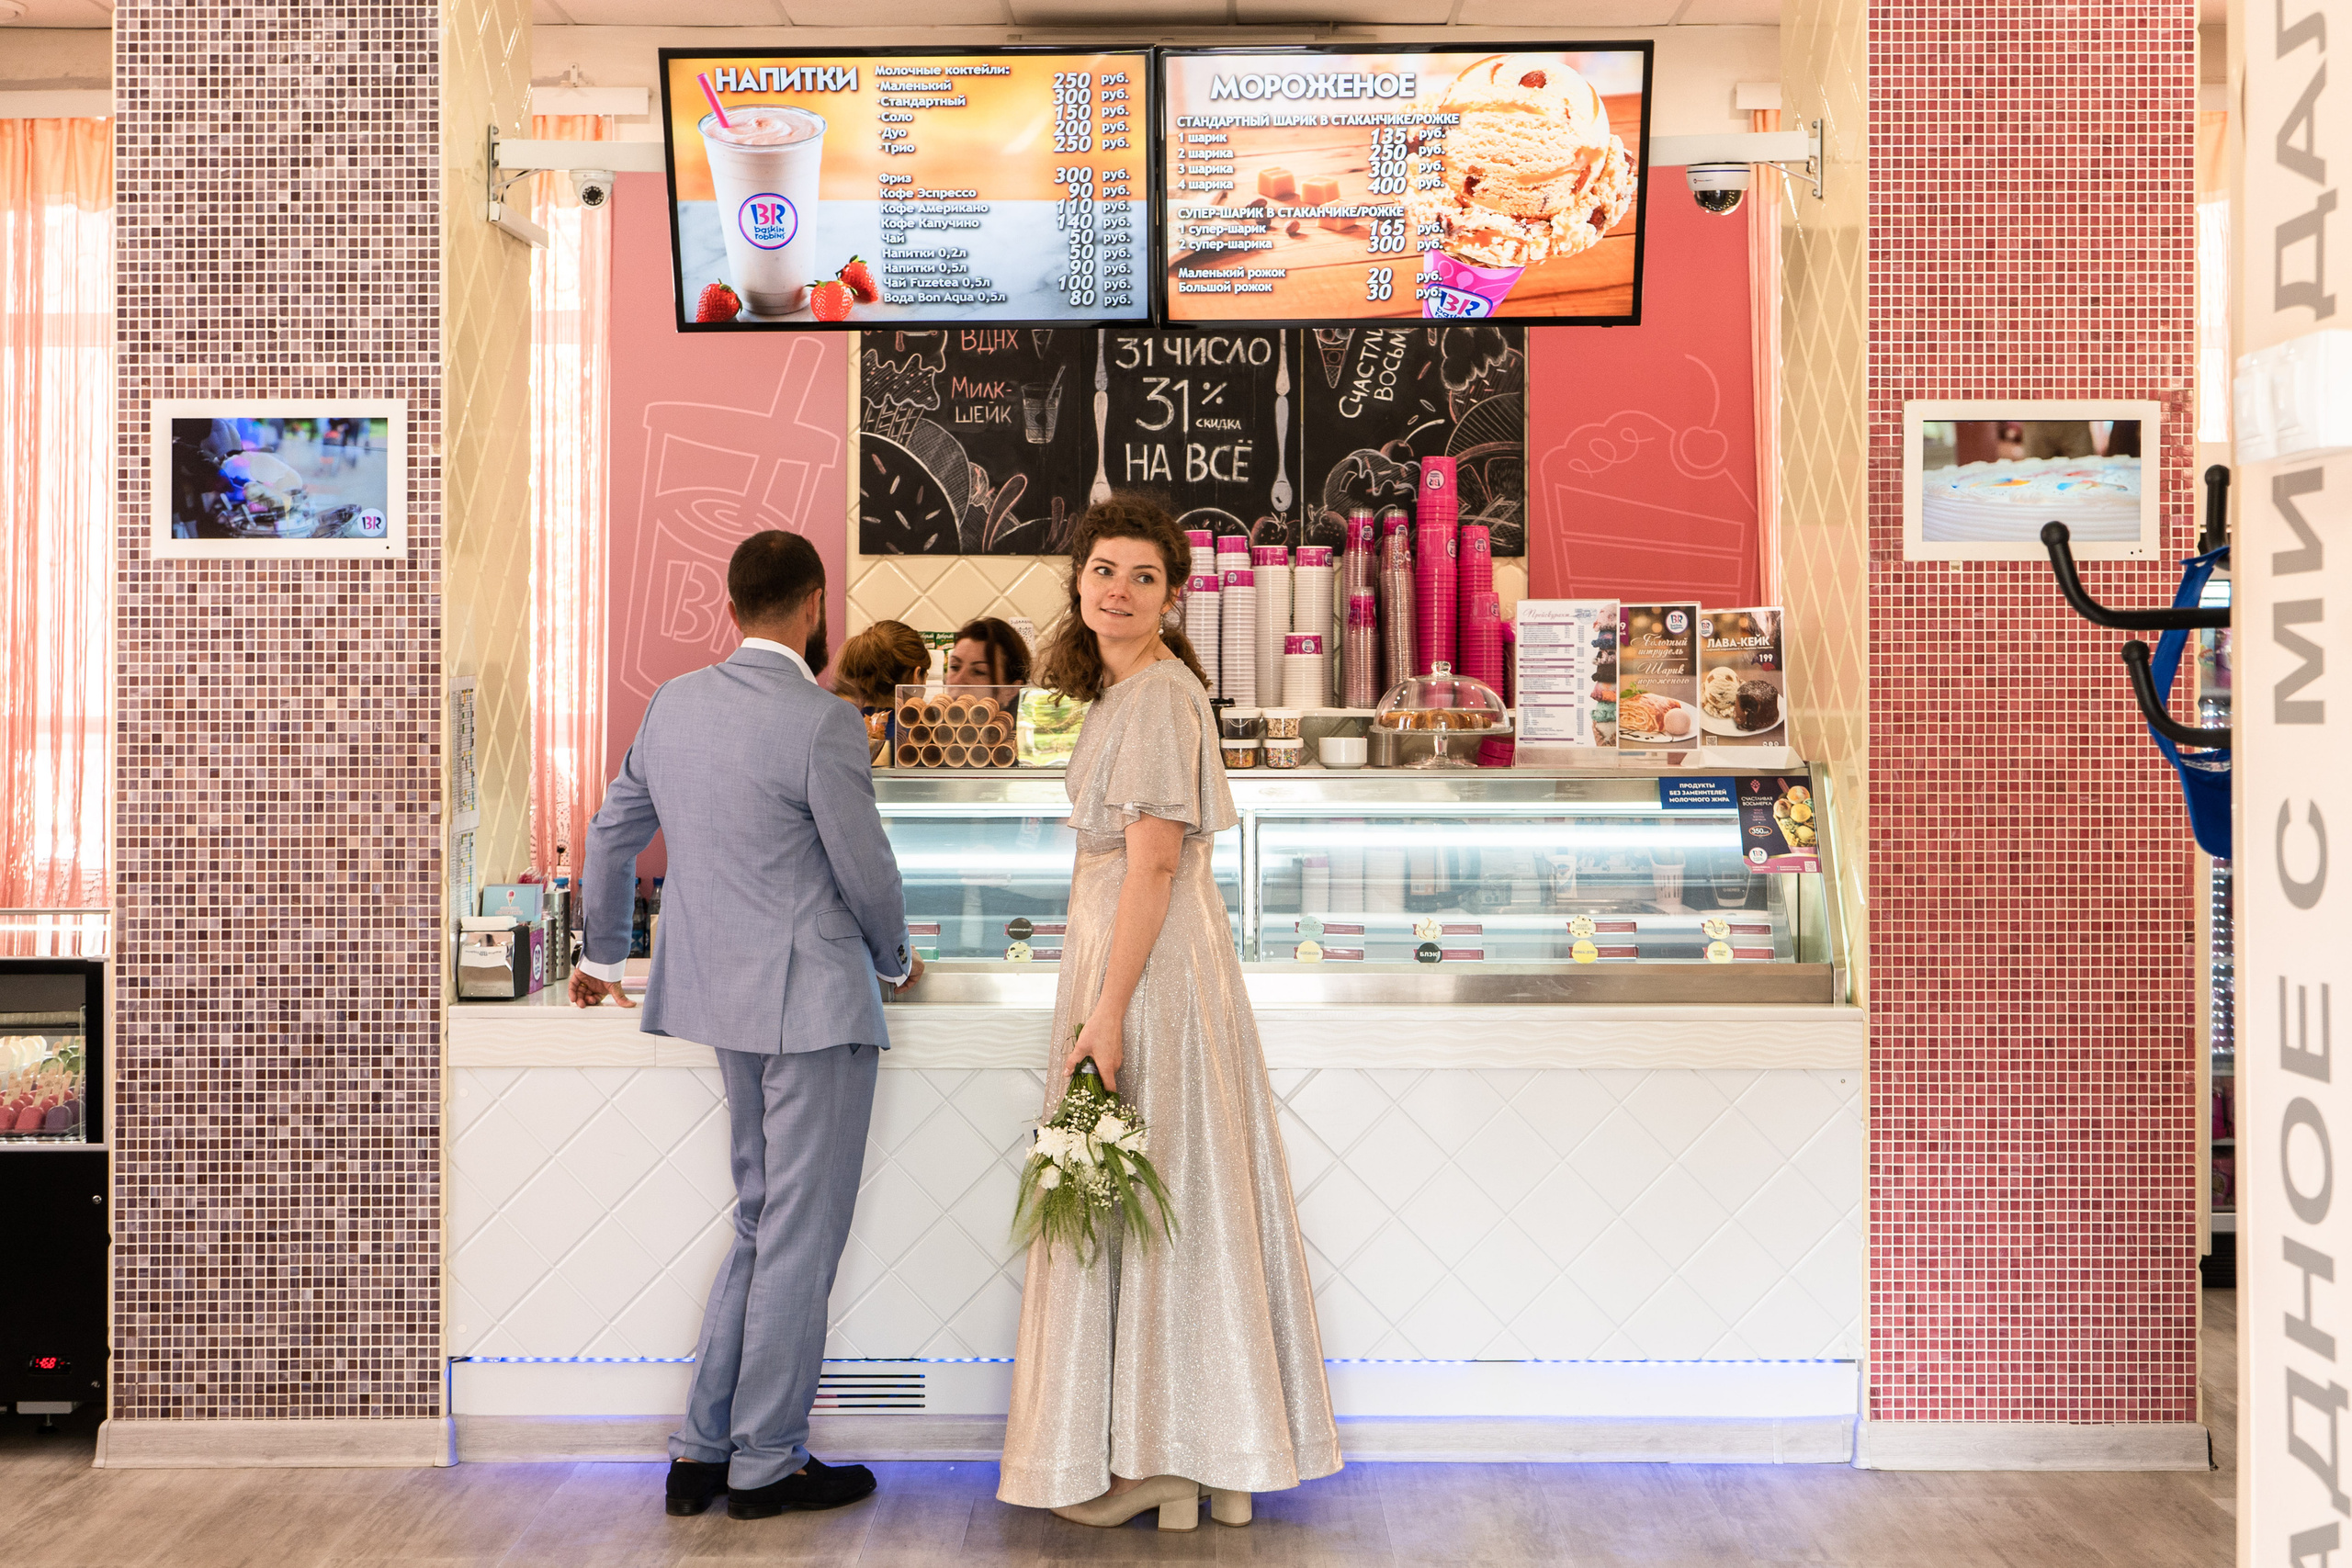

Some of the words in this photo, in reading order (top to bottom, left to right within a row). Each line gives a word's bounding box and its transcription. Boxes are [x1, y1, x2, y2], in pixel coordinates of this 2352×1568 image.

[875, 64, 942, 76] Молочные
[944, 63, 1011, 76] коктейли:
[715, 66, 857, 92] НАПИТКИ
[1052, 73, 1091, 89] 250
[1101, 72, 1129, 85] руб.
[1210, 73, 1416, 100] МОРОЖЕНОЕ
[1052, 88, 1091, 105] 300
[1101, 88, 1129, 102] руб.
[1055, 104, 1091, 120] 150
[1101, 105, 1129, 118] руб.
[1053, 119, 1091, 136] 200
[1102, 120, 1130, 134] руб.
[1176, 113, 1271, 130] СТАНДАРТНЫЙ
[1272, 115, 1317, 127] ШАРИК
[1319, 115, 1329, 127] В
[1053, 135, 1092, 152] 250
[1102, 137, 1130, 150] руб.
[1177, 132, 1184, 143] 1
[1187, 133, 1228, 145] шарик
[1370, 128, 1408, 145] 135
[1419, 126, 1447, 141] руб.
[1177, 148, 1186, 159] 2
[1187, 149, 1235, 161] шарика
[1368, 143, 1408, 162] 250
[1418, 143, 1446, 157] руб.
[1054, 166, 1092, 184] 300
[1102, 168, 1130, 182] руб.
[1177, 164, 1186, 175] 3
[1187, 164, 1235, 176] шарика
[1367, 160, 1408, 178] 300
[1418, 160, 1446, 174] руб.
[878, 173, 912, 186] Фриз
[1177, 179, 1186, 190] 4
[1187, 180, 1235, 192] шарика
[1367, 176, 1408, 195] 400
[1418, 176, 1445, 190] руб.
[879, 187, 914, 200] Кофе
[917, 187, 978, 200] Эспрессо
[1069, 182, 1093, 198] 90
[1102, 185, 1130, 198] руб.
[750, 203, 786, 225] BR
[880, 203, 915, 215] Кофе
[918, 203, 989, 215] Американо
[1057, 198, 1093, 214] 110
[1102, 200, 1130, 213] руб.
[1177, 207, 1264, 219] СУПЕР-ШАРИК
[1266, 207, 1275, 218] В
[754, 225, 785, 234] baskin
[880, 218, 915, 231] Кофе
[918, 218, 980, 230] Капучино
[1057, 213, 1093, 230] 140
[1102, 216, 1131, 230] руб.
[1369, 220, 1406, 236] 165
[1417, 221, 1444, 236] руб.
[754, 231, 786, 241] robbins
[881, 231, 906, 243] Чай
[1069, 229, 1094, 244] 50
[1102, 231, 1131, 245] руб.
[1178, 224, 1185, 234] 1
[1188, 224, 1267, 236] супер-шарик
[1069, 243, 1094, 260] 50
[1103, 247, 1131, 260] руб.
[1178, 239, 1186, 250] 2
[1188, 240, 1273, 252] супер-шарика
[1367, 235, 1406, 253] 300
[1417, 238, 1444, 252] руб.
[882, 248, 935, 258] Напитки
[937, 247, 967, 260] 0,2л
[882, 263, 935, 274] Напитки
[938, 263, 967, 275] 0,5л
[1069, 259, 1094, 276] 90
[1103, 263, 1131, 276] руб.
[1178, 266, 1245, 279] Маленький
[1247, 268, 1286, 280] рожок
[883, 277, 907, 288] Чай
[910, 277, 959, 288] Fuzetea
[961, 277, 991, 288] 0,5л
[1058, 275, 1094, 290] 100
[1103, 278, 1131, 292] руб.
[1366, 267, 1393, 285] 20
[1416, 270, 1443, 284] руб.
[1178, 281, 1232, 293] Большой
[1234, 282, 1273, 294] рожок
[1365, 283, 1393, 300] 30
[1415, 286, 1443, 300] руб.
[883, 292, 915, 305] Вода
[917, 292, 942, 303] Bon
[943, 292, 975, 305] Aqua
[977, 291, 1007, 303] 0,5л
[1069, 289, 1095, 306] 80
[1103, 294, 1132, 307] руб.
[1440, 290, 1481, 317] BR
[961, 329, 1019, 355] ВДНХ
[1114, 337, 1155, 369] 31
[1162, 336, 1272, 366] ЧИСЛО
[1125, 443, 1172, 482] НА
[1186, 439, 1253, 483] ВСЁ
[361, 516, 381, 530] BR
[1670, 615, 1683, 624] BR
[1707, 634, 1770, 649] ЛАВА-КЕЙК
[1637, 648, 1684, 659] штрудель
[1758, 653, 1773, 663] 199
[1636, 661, 1685, 677] Шарик
